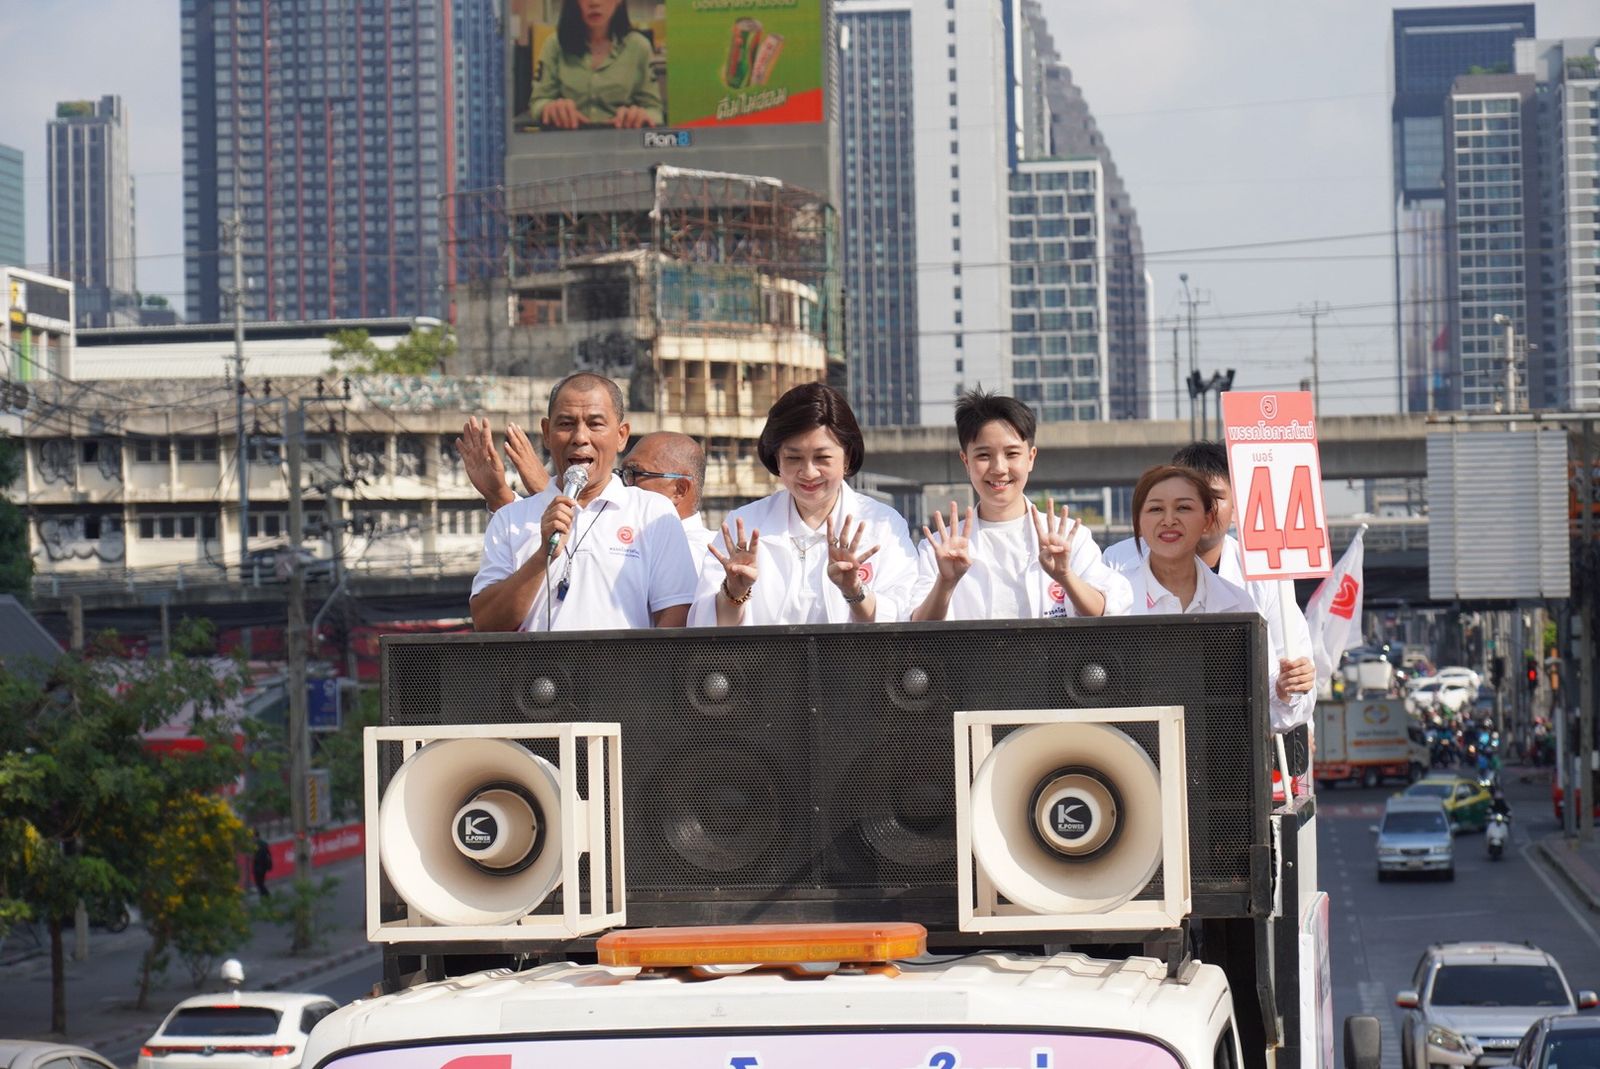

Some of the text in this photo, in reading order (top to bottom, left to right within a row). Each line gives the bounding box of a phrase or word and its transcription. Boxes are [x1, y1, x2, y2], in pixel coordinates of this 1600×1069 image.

[644, 132, 677, 147] Plan
[1228, 420, 1314, 439] พรรคโอกาสใหม่
[1252, 449, 1273, 462] เบอร์
[1243, 466, 1324, 568] 44
[1057, 804, 1084, 823] K
[465, 816, 490, 835] K
